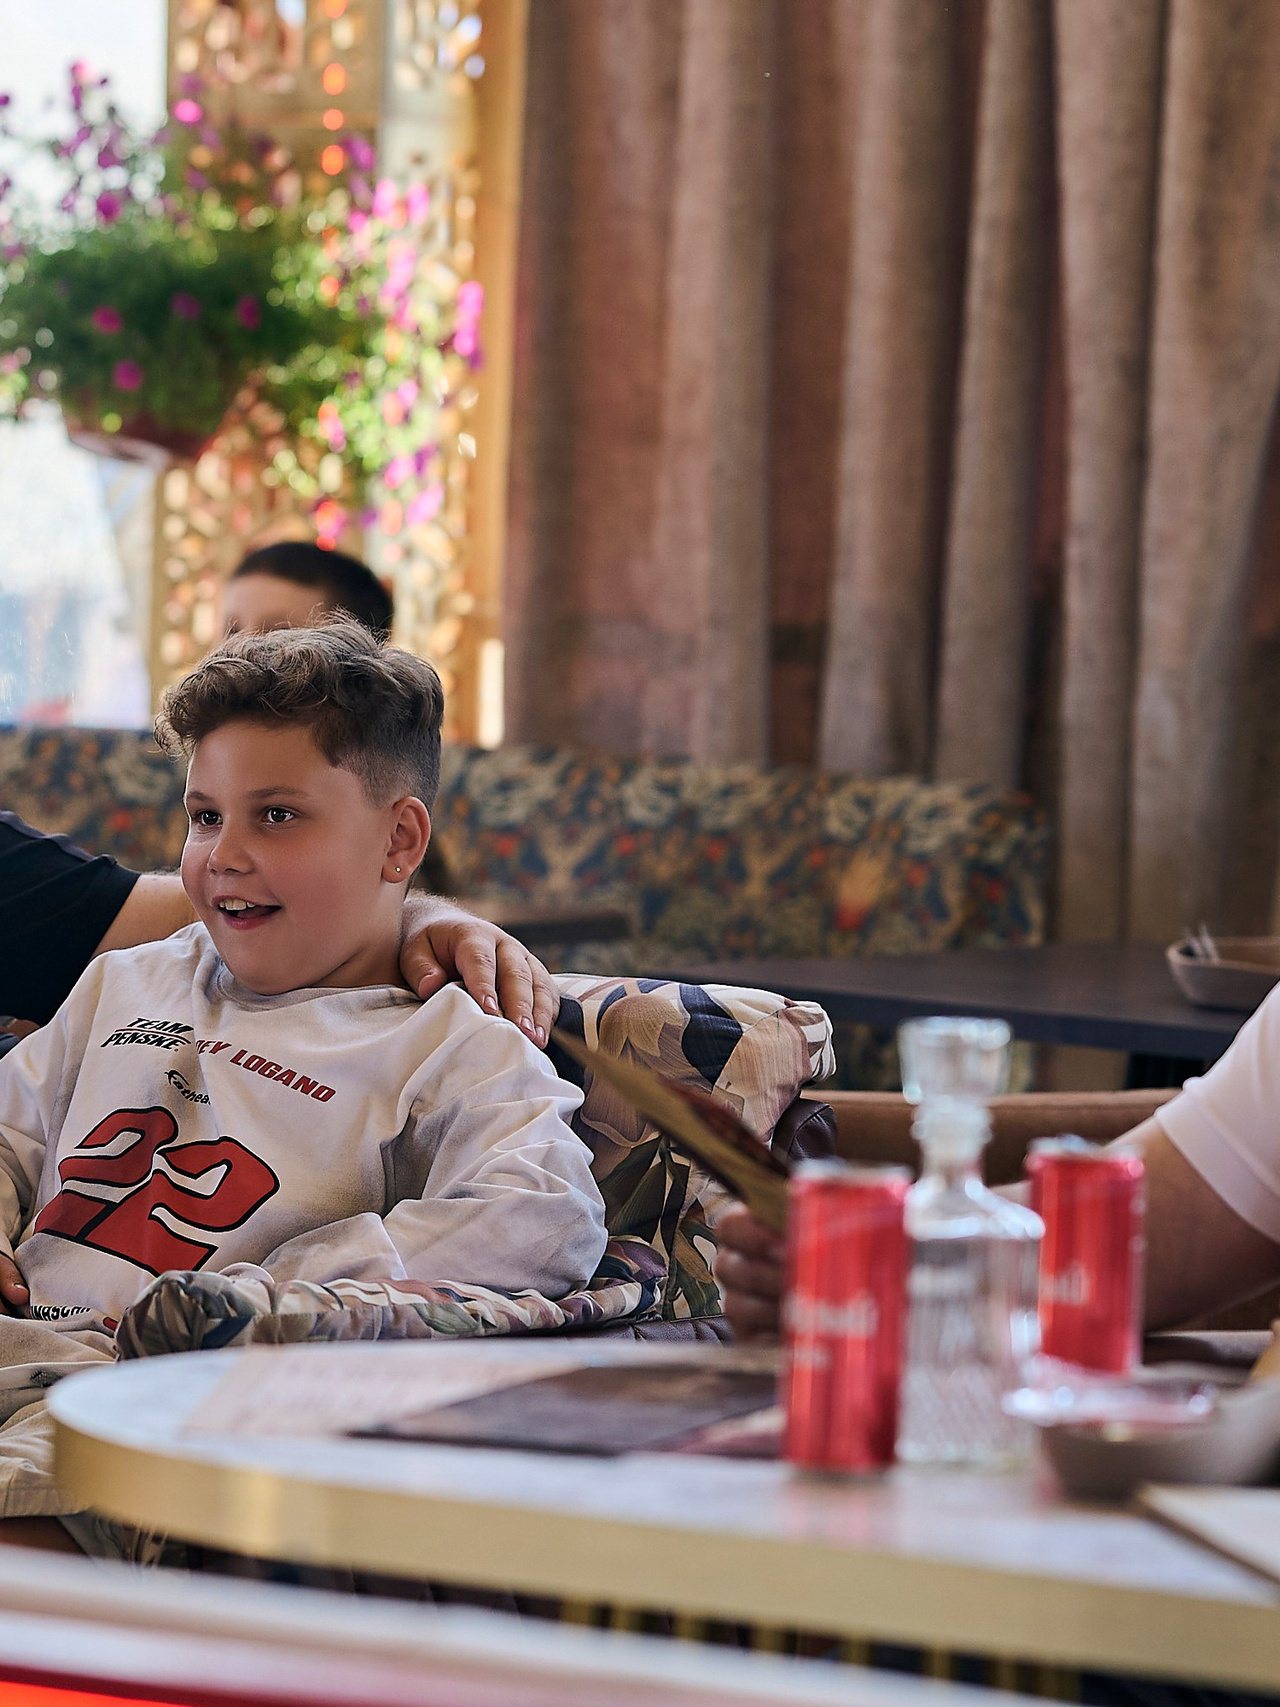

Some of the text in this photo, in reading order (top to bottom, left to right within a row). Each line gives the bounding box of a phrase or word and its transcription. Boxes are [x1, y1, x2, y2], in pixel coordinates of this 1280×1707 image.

[100, 1032, 186, 1050] PENSKE
[126, 1017, 195, 1034] TEAM
[164, 1069, 212, 1105] fathea
[195, 1039, 337, 1103] EY LOGANO
[32, 1105, 280, 1278] 22
